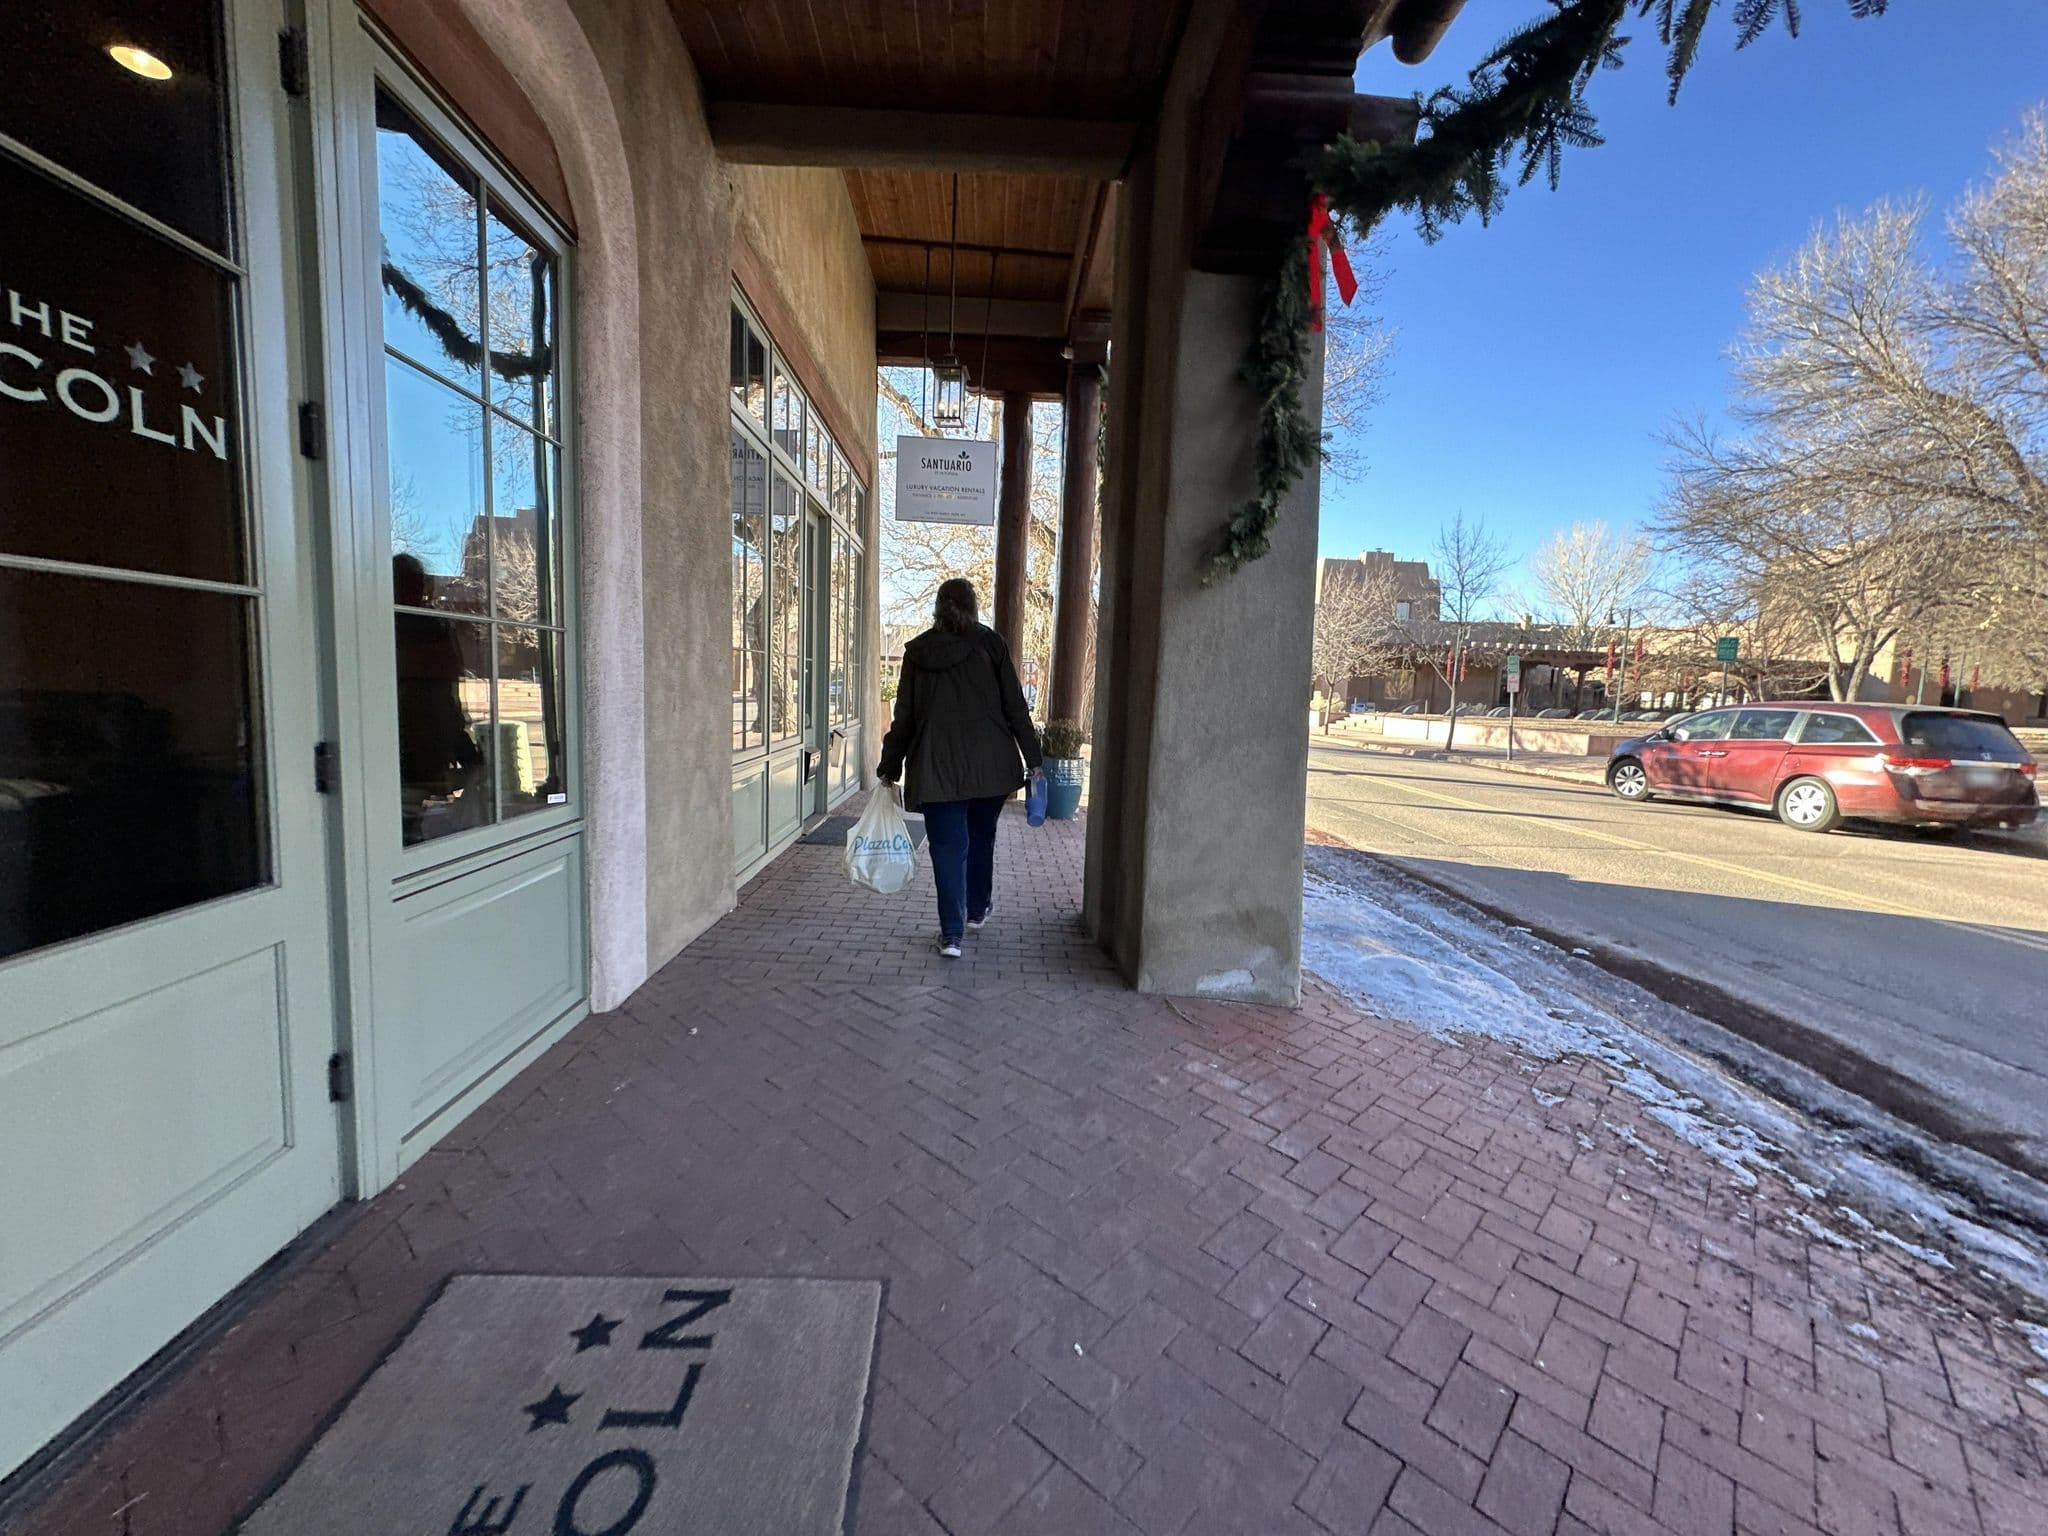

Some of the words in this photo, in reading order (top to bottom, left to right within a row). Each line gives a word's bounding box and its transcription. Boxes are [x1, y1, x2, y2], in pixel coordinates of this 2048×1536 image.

[0, 342, 228, 460] COLN
[921, 457, 972, 472] SANTUARIO
[906, 483, 928, 491] LUXURY
[961, 486, 985, 494] RENTALS
[854, 836, 891, 853] Plaza
